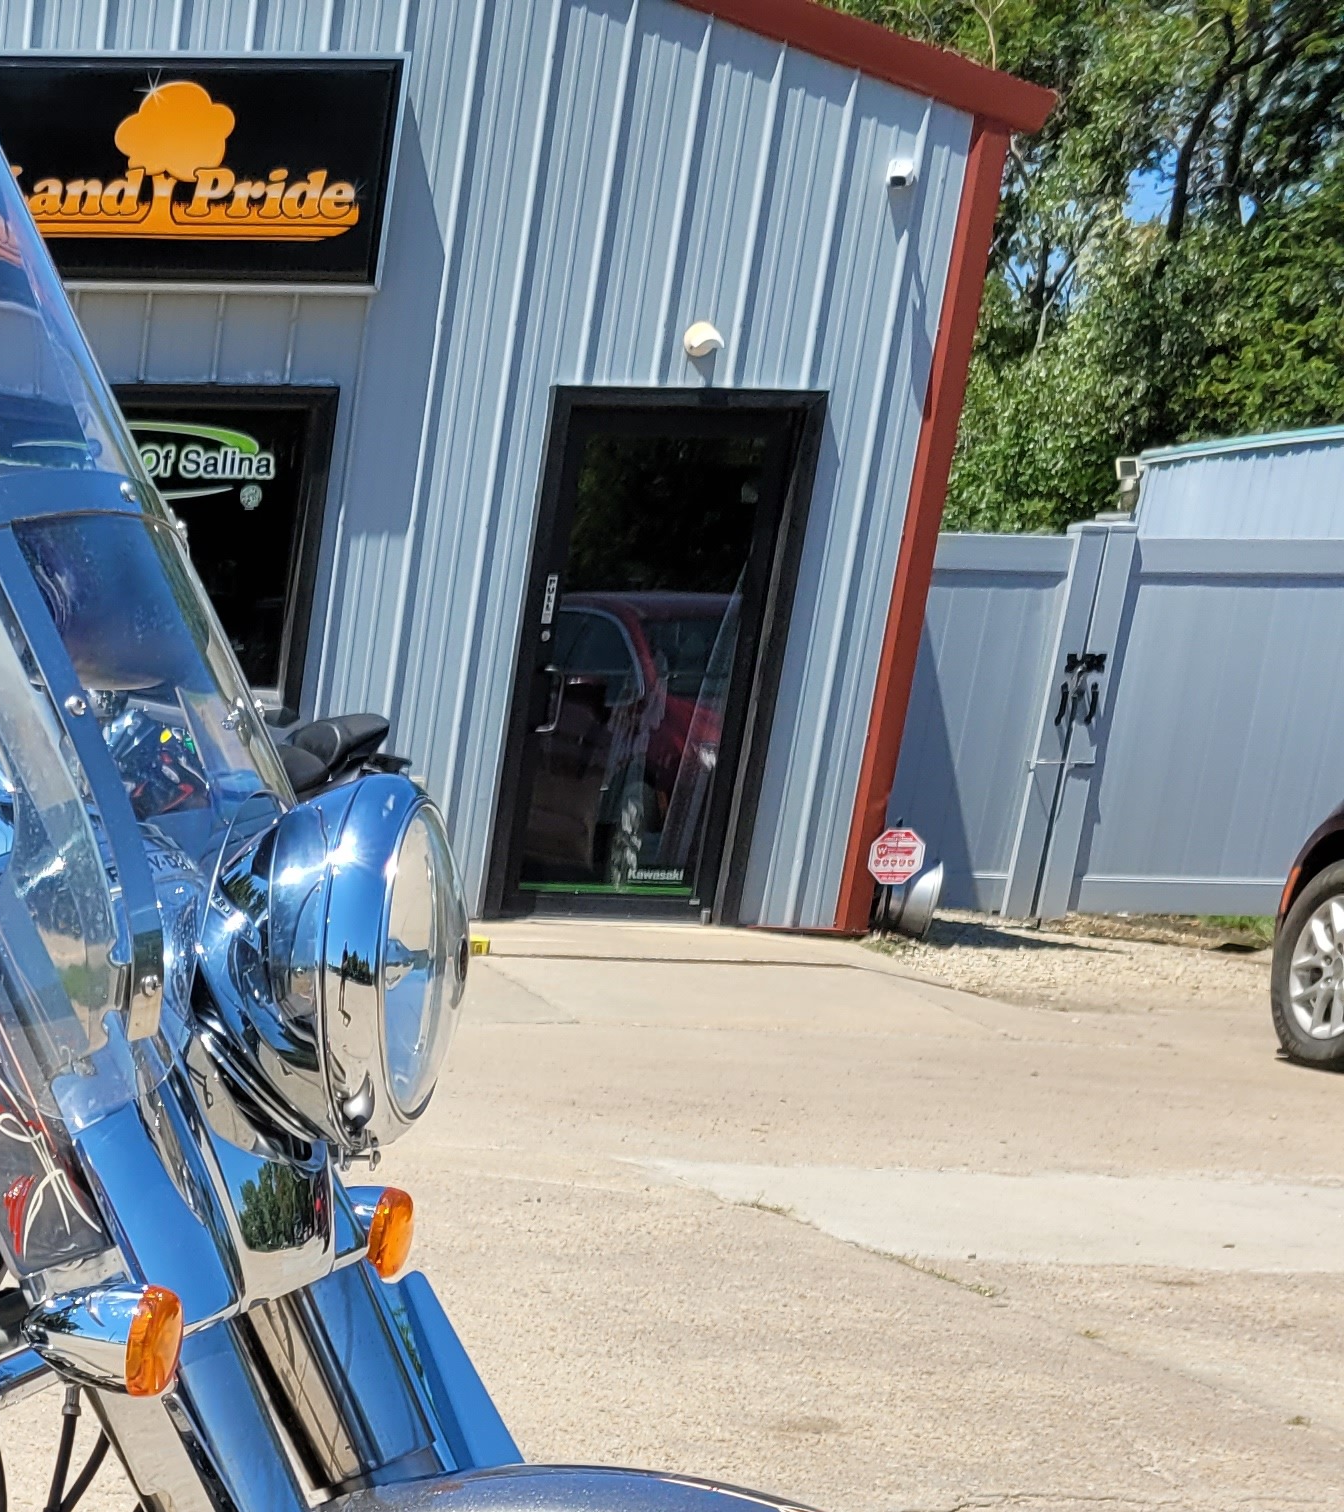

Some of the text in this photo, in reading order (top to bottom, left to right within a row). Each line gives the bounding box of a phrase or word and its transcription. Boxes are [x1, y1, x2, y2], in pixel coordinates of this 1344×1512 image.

[11, 165, 358, 220] and Pride
[140, 447, 272, 479] Of Salina
[628, 869, 684, 881] Kawasaki
